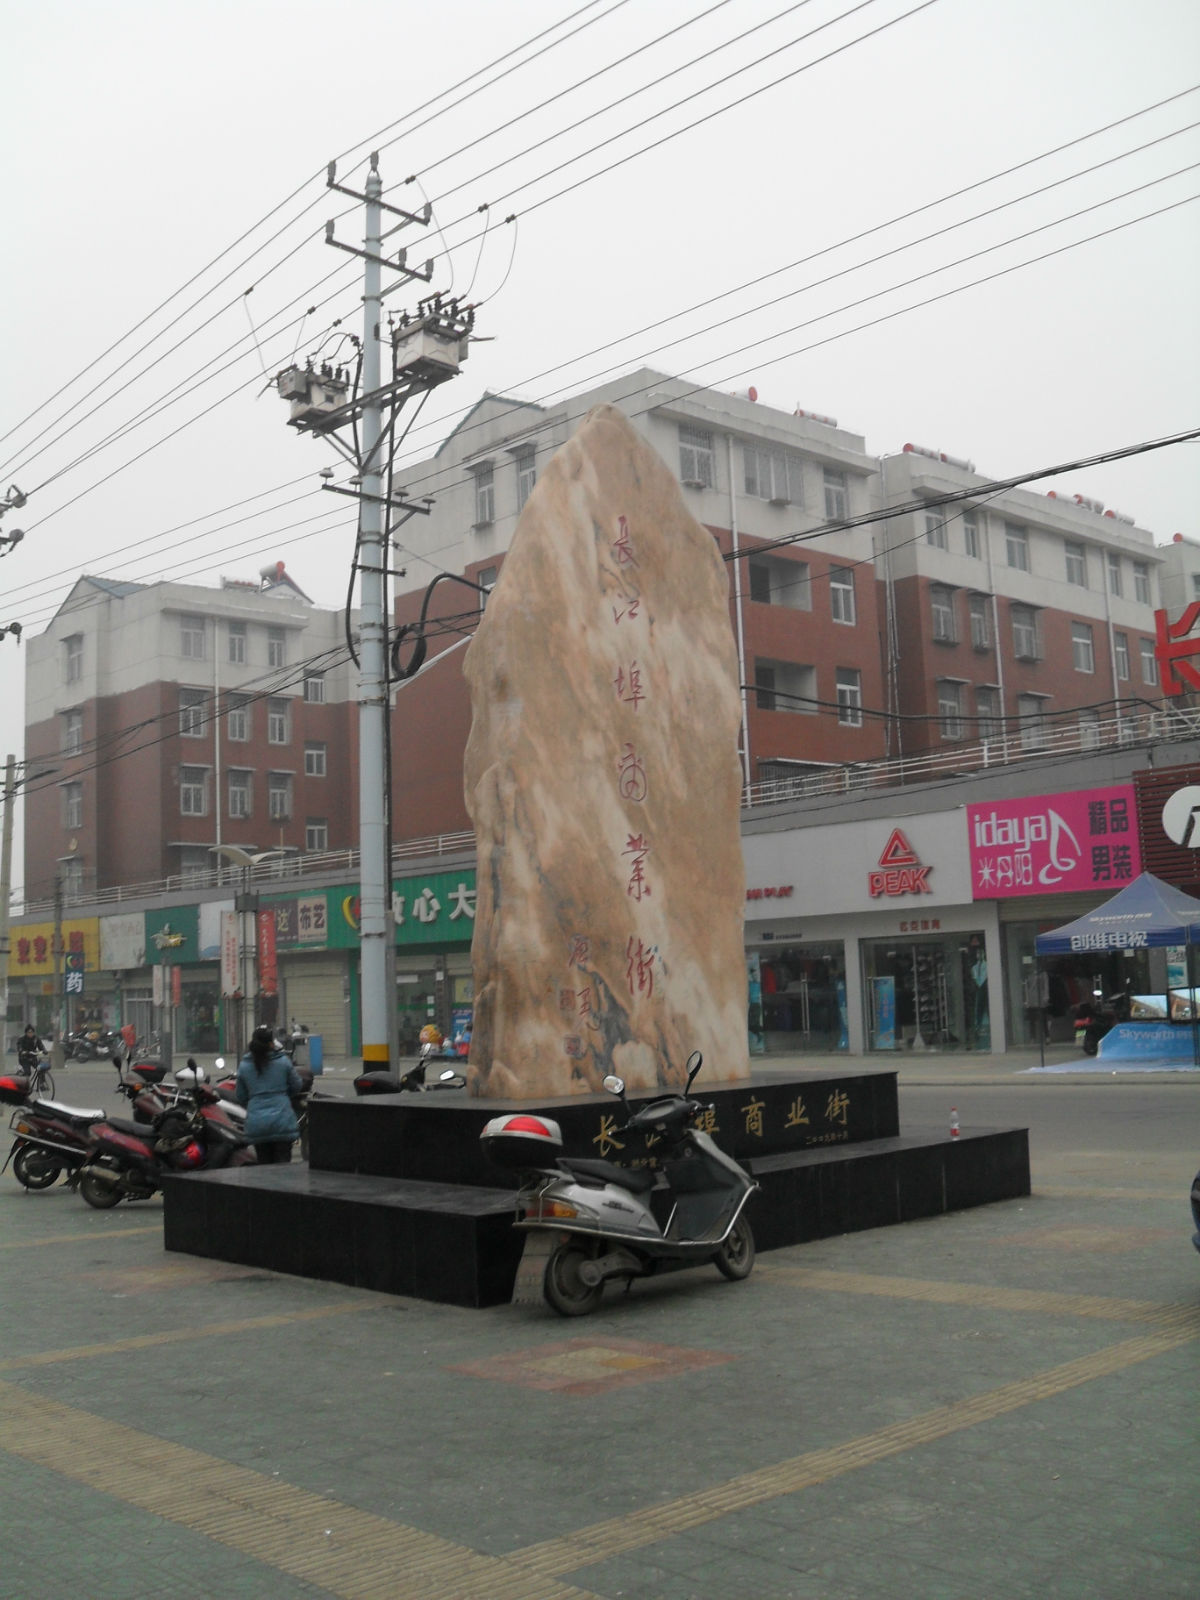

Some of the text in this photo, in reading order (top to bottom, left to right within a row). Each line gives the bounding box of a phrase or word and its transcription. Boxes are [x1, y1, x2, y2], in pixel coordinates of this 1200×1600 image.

[1088, 798, 1129, 836] 精品
[1091, 845, 1132, 881] 男装
[868, 866, 933, 898] PEAK
[300, 903, 326, 931] 布艺
[1070, 930, 1149, 950] 创维电视
[65, 972, 83, 993] 药
[1119, 1028, 1174, 1042] Skyworth
